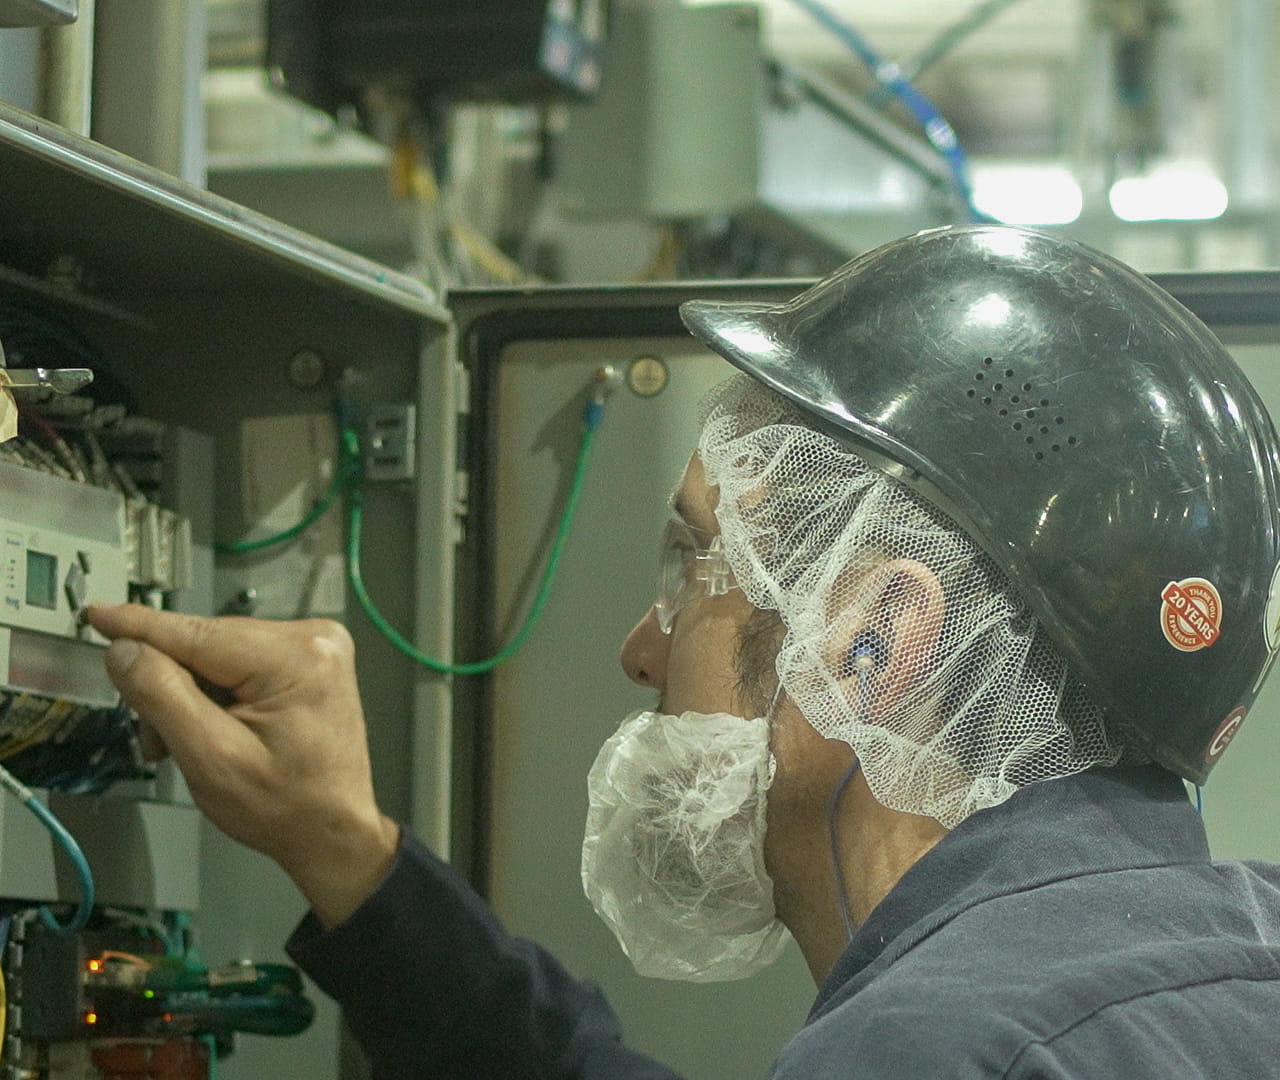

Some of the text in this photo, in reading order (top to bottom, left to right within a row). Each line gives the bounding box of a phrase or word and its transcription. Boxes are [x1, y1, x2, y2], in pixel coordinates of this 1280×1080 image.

[1189, 588, 1211, 602] THANK
[1168, 590, 1215, 640] 20 YEARS
[1168, 614, 1196, 644] EXPERIENCE
